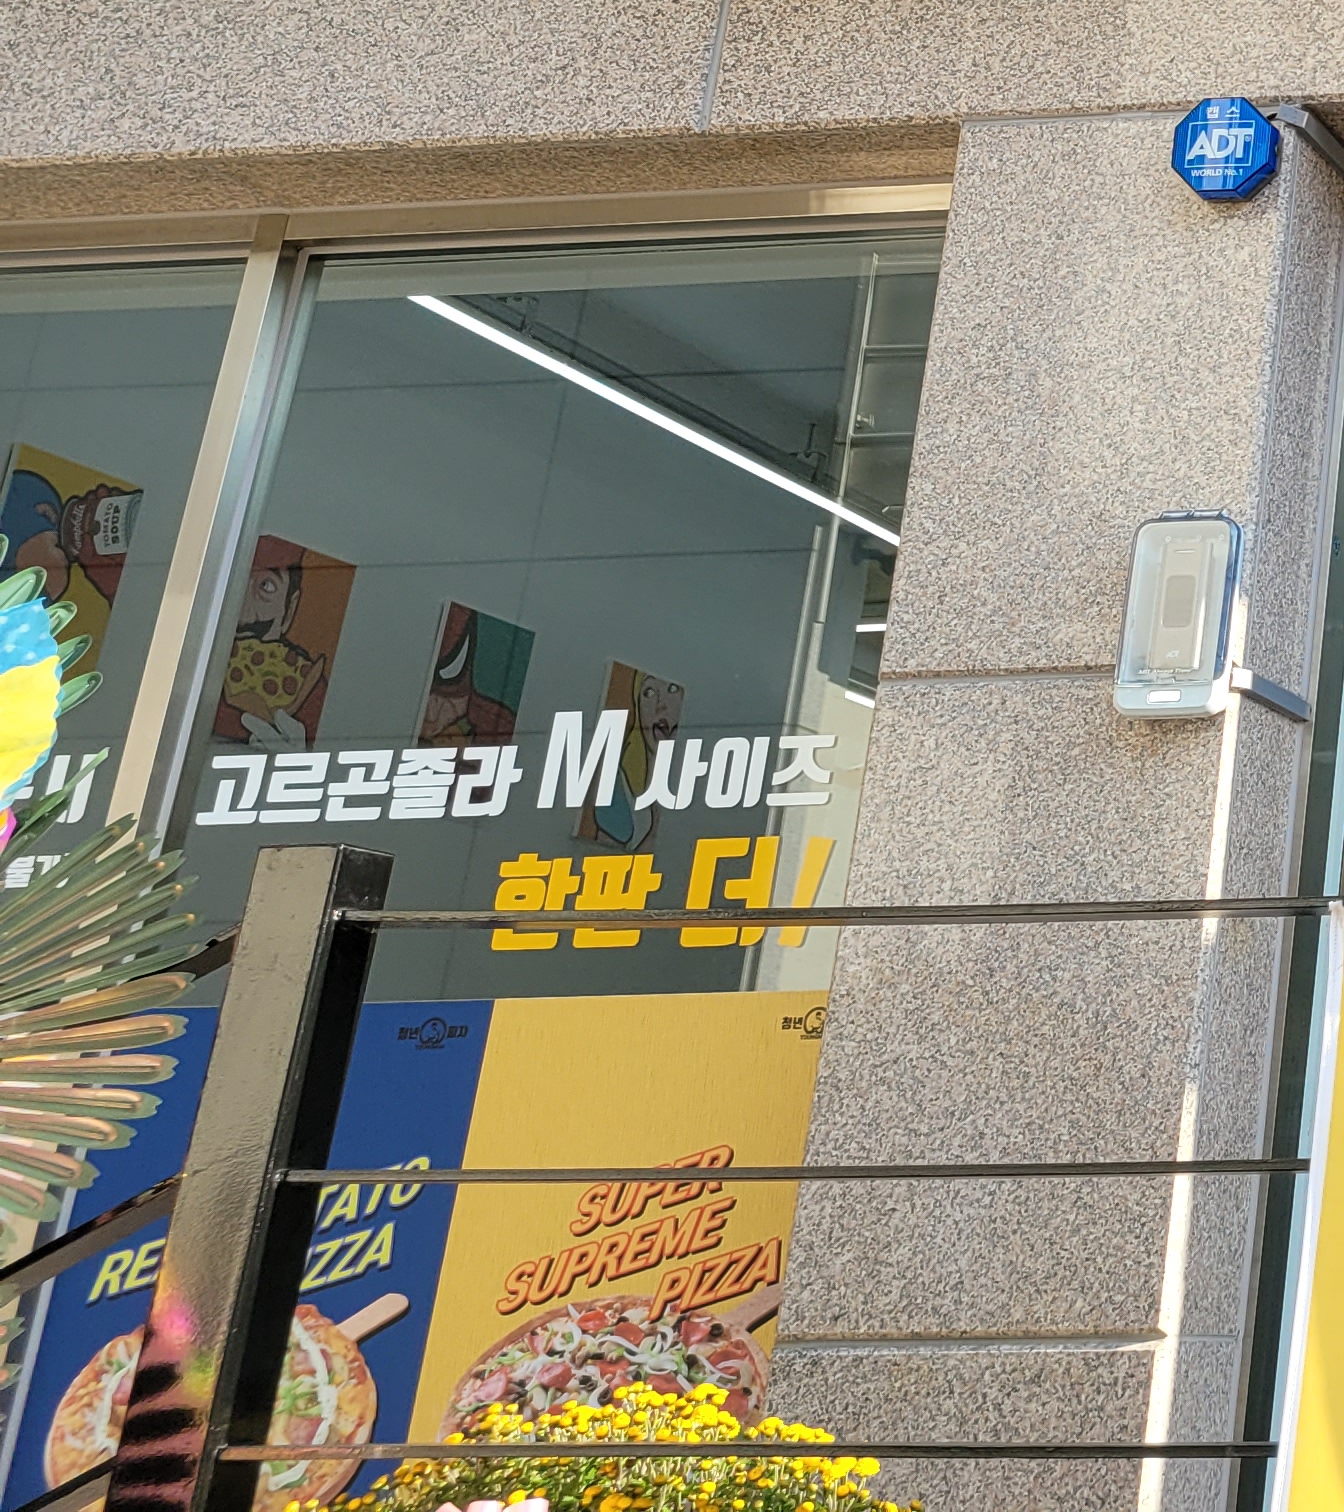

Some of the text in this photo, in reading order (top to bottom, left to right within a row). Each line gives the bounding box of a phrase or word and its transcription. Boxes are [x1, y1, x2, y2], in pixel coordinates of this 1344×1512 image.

[1187, 128, 1254, 160] ADT
[195, 709, 837, 826] 고르곤졸라 M 사이즈
[491, 853, 662, 950] 한판
[315, 1157, 430, 1230] TATO
[569, 1144, 734, 1236] SUPER
[86, 1221, 396, 1304] RE ZZA
[496, 1196, 737, 1315] SUPREME
[647, 1236, 783, 1323] PIZZA
